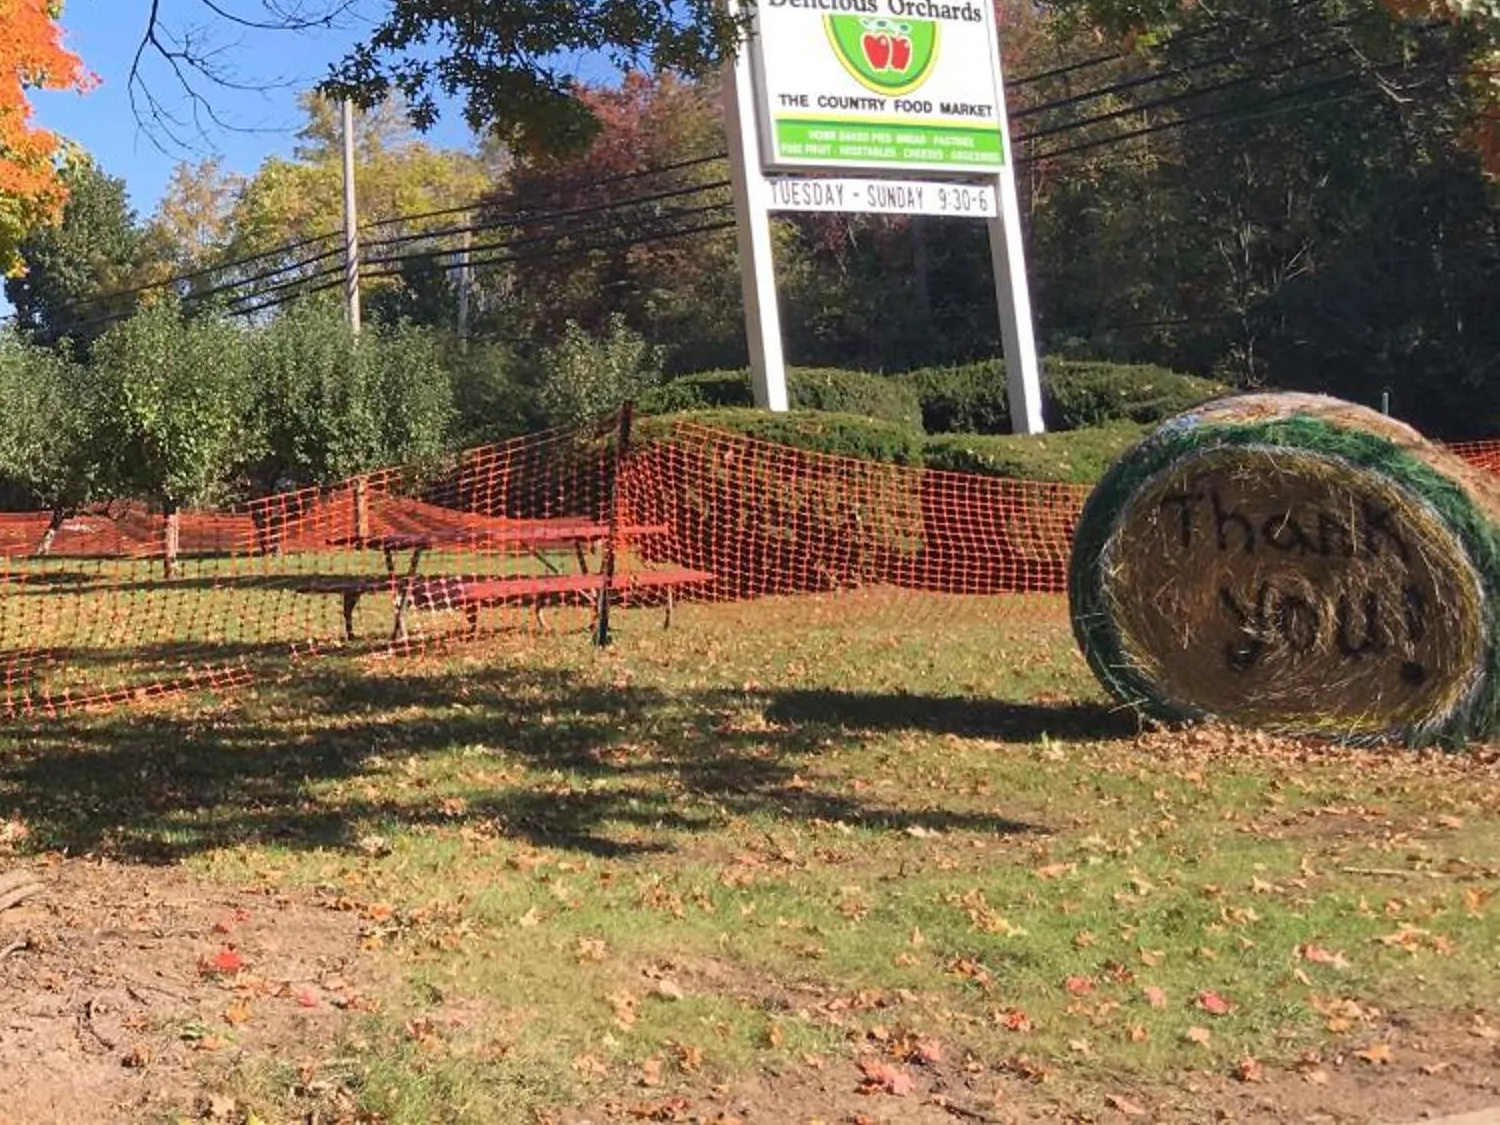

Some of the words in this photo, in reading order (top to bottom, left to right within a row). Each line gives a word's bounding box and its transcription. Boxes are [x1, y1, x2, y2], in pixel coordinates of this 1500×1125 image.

[778, 94, 809, 107] THE
[817, 95, 886, 111] COUNTRY
[894, 99, 932, 113] FOOD
[940, 102, 992, 117] MARKET
[770, 182, 844, 205] TUESDAY
[867, 186, 924, 209] SUNDAY
[937, 188, 988, 211] 9:30-6
[1161, 488, 1410, 563] Thank
